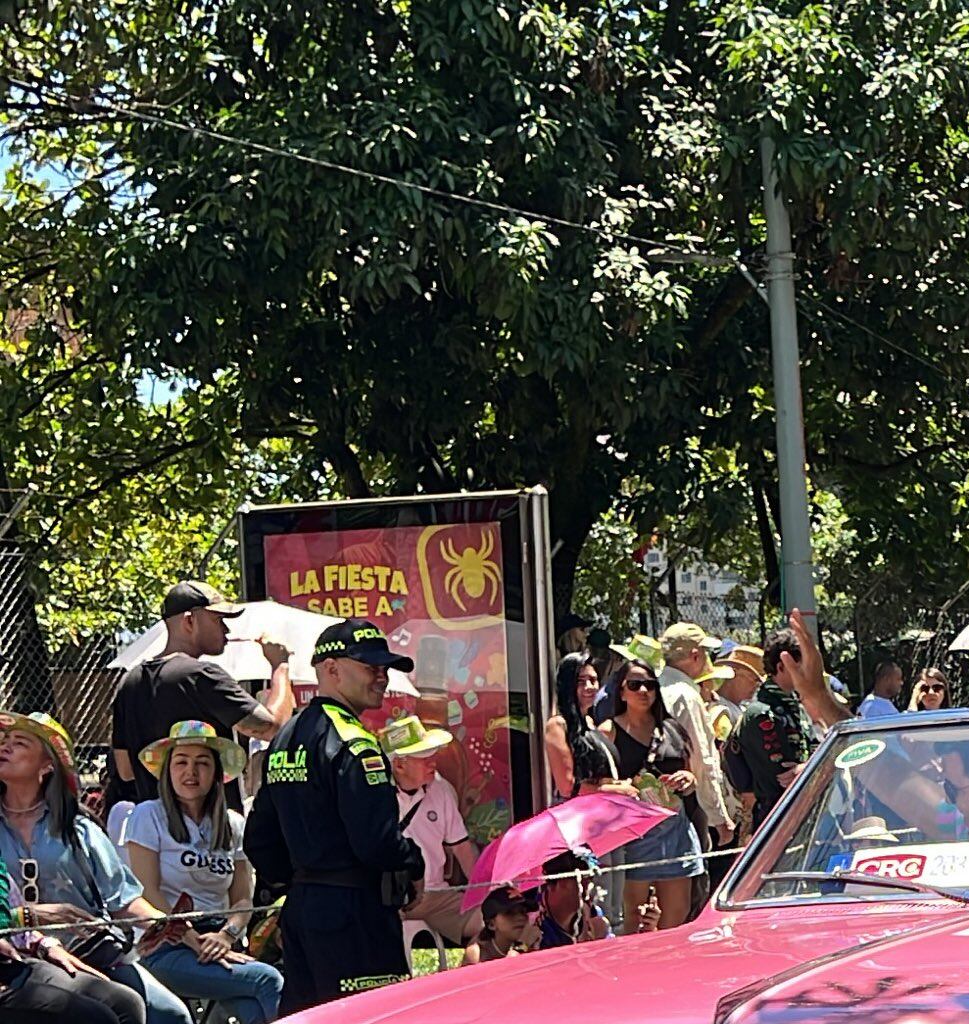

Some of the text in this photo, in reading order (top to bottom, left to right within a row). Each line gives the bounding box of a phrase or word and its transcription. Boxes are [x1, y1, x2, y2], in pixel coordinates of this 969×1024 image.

[290, 564, 409, 597] LA FIESTA
[308, 596, 394, 618] SABE A
[180, 849, 234, 875] GUESS
